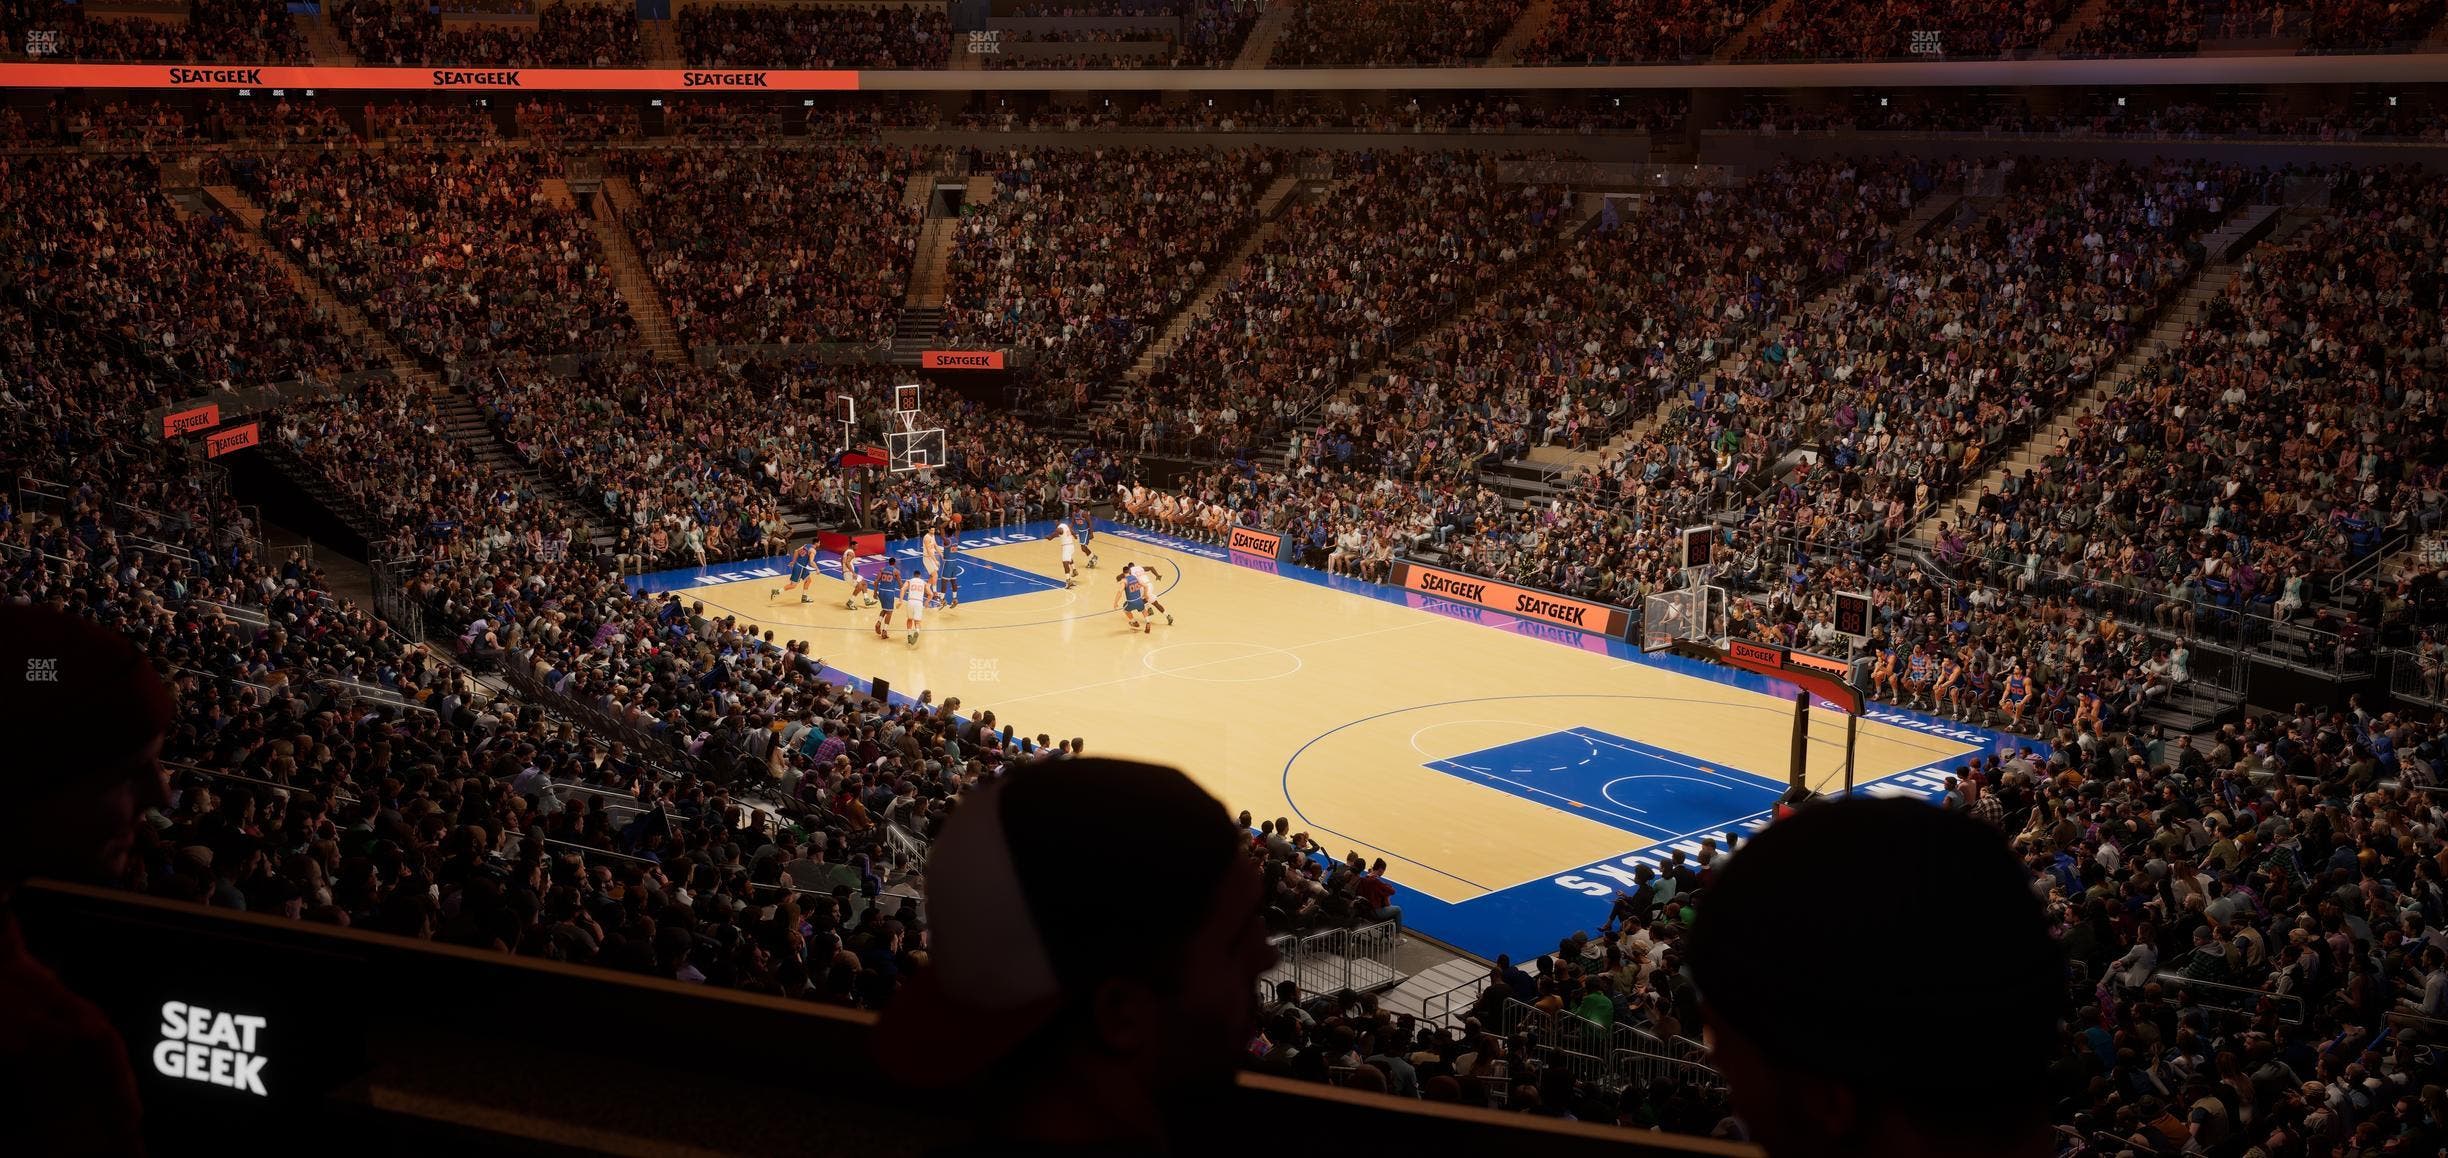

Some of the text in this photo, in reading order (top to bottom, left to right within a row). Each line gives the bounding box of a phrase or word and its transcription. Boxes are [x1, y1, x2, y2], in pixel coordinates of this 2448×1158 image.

[170, 68, 263, 85] SEATGEEK
[433, 70, 520, 86] SEATGEEK
[683, 72, 767, 87] SEATGEEK
[936, 355, 990, 367] SEATGEEK
[173, 412, 209, 432] SEATGEEK
[1233, 532, 1277, 555] SEATGEEK
[694, 567, 780, 585] NEW
[1420, 573, 1487, 603] SEATGEEK
[1515, 594, 1587, 626] SEATGEEK
[1736, 646, 1775, 663] SEATGEEK
[161, 1000, 267, 1053] SEAT
[153, 1040, 268, 1097] GEEK
